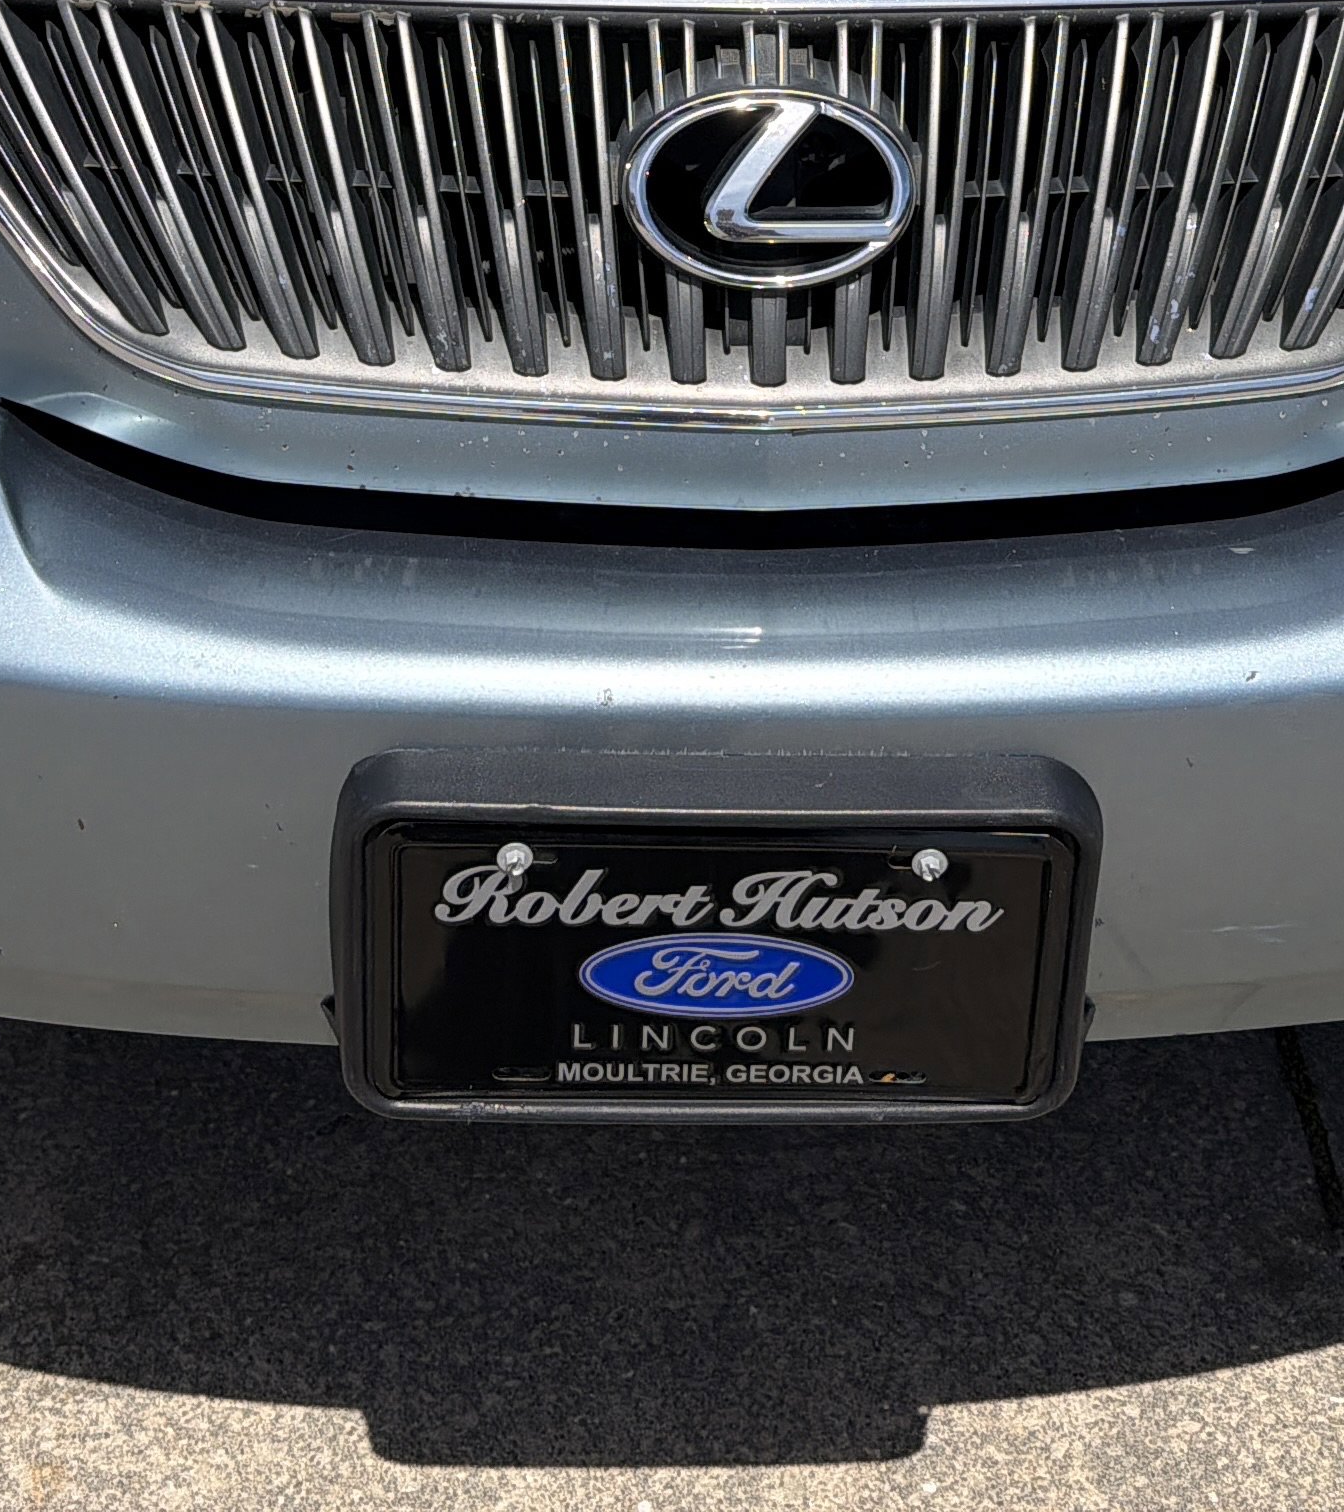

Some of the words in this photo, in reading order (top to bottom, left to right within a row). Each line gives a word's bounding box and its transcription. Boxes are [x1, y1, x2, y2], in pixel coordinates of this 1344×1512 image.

[434, 864, 715, 926] Robert
[719, 870, 1005, 933] Hutson
[633, 946, 801, 999] Ford
[572, 1023, 855, 1052] LINCOLN
[557, 1062, 716, 1086] MOULTRIE,
[725, 1064, 864, 1085] GEORGIA
